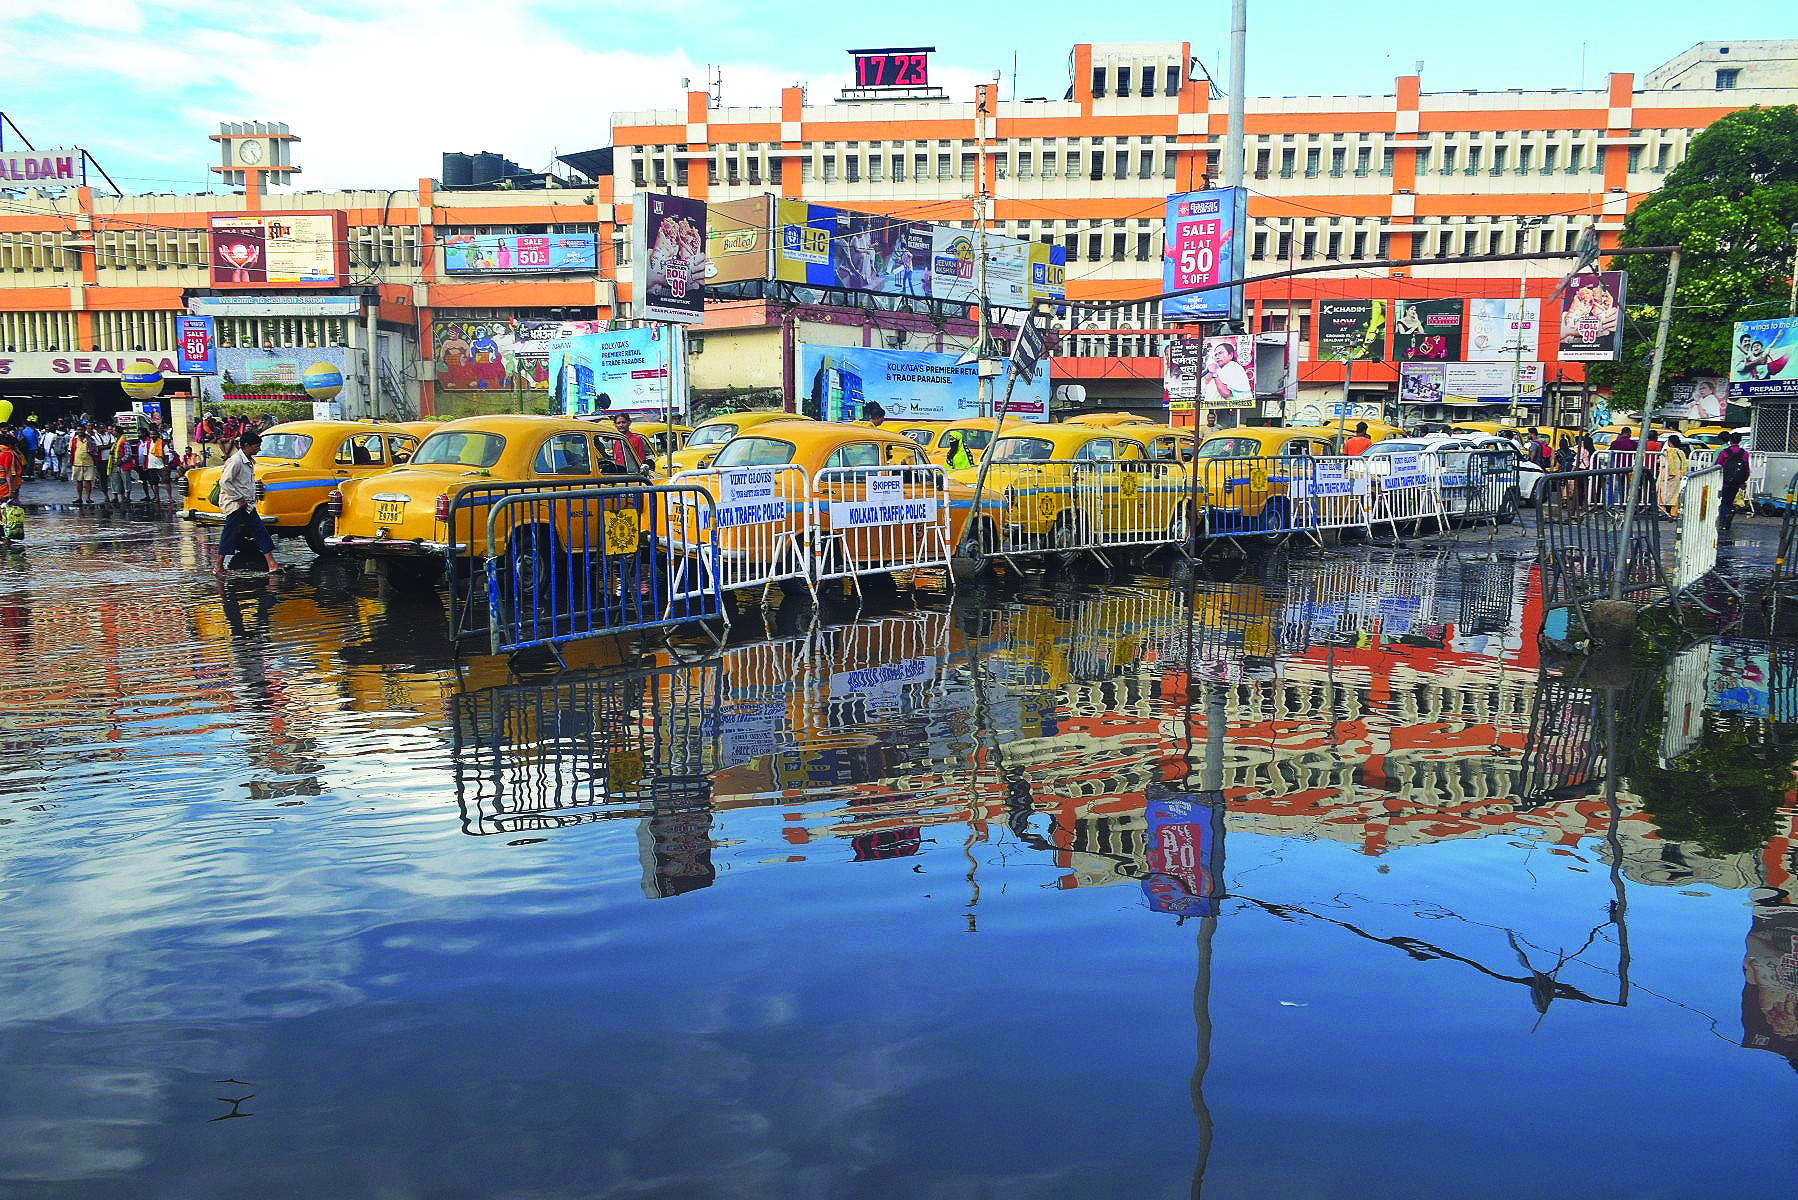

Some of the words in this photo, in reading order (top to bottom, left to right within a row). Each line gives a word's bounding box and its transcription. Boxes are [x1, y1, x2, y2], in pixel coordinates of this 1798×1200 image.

[895, 56, 926, 84] 23
[1182, 223, 1216, 237] SALE
[803, 230, 826, 253] LIC
[1183, 240, 1212, 249] FLAT
[519, 250, 539, 264] 50
[1180, 248, 1214, 273] 50
[666, 269, 687, 280] ROLL
[1047, 267, 1065, 285] LIC
[673, 279, 685, 296] 99
[219, 296, 255, 304] Welcome
[1332, 318, 1357, 326] NOW
[1579, 323, 1598, 331] ROLL
[1583, 330, 1595, 342] 99
[186, 342, 205, 355] 50
[601, 341, 629, 350] KOLKATA'S
[887, 363, 924, 373] KOLKATA'S
[925, 365, 960, 375] PREMIERE
[892, 373, 916, 382] TRADE
[1522, 384, 1536, 394] LIC
[1749, 385, 1783, 393] PREPAID
[748, 472, 772, 484] GLOVES
[872, 480, 901, 491] SKIPPER
[1324, 482, 1340, 494] TRAFFIC
[735, 504, 762, 525] TRAFFIC
[762, 501, 785, 521] POLICE
[849, 506, 879, 525] KOLKATA
[879, 504, 905, 522] TRAFFIC
[905, 503, 927, 520] POLICE
